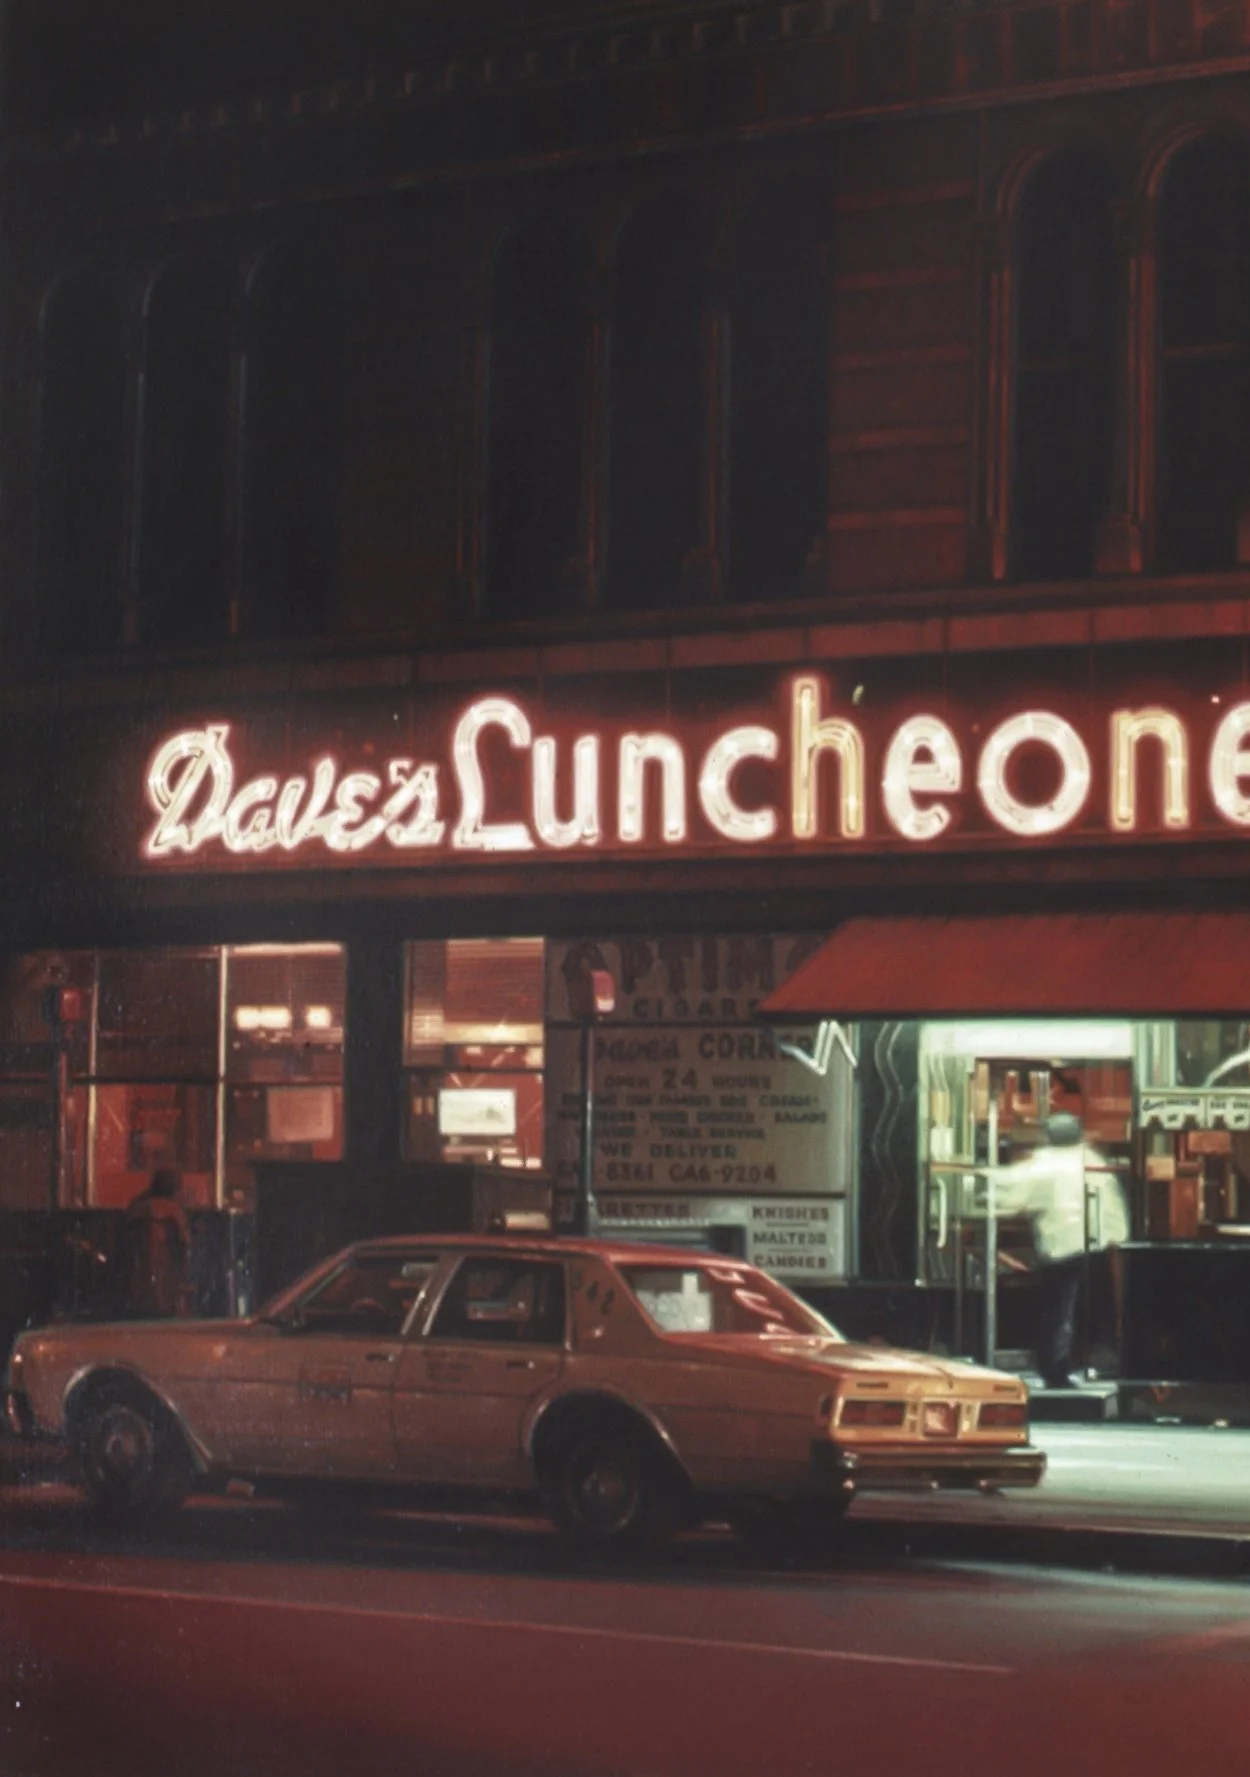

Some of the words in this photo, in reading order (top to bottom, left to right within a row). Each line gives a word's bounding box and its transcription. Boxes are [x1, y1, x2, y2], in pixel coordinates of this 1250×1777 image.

[604, 1076, 649, 1089] OPEN
[662, 1068, 697, 1089] 24
[712, 1076, 773, 1089] HOURS
[601, 1143, 632, 1157] WE
[651, 1144, 737, 1159] DELIVER
[669, 1162, 777, 1183] CA6-9204
[752, 1205, 830, 1221] KNISHES
[753, 1254, 827, 1269] CANDIES
